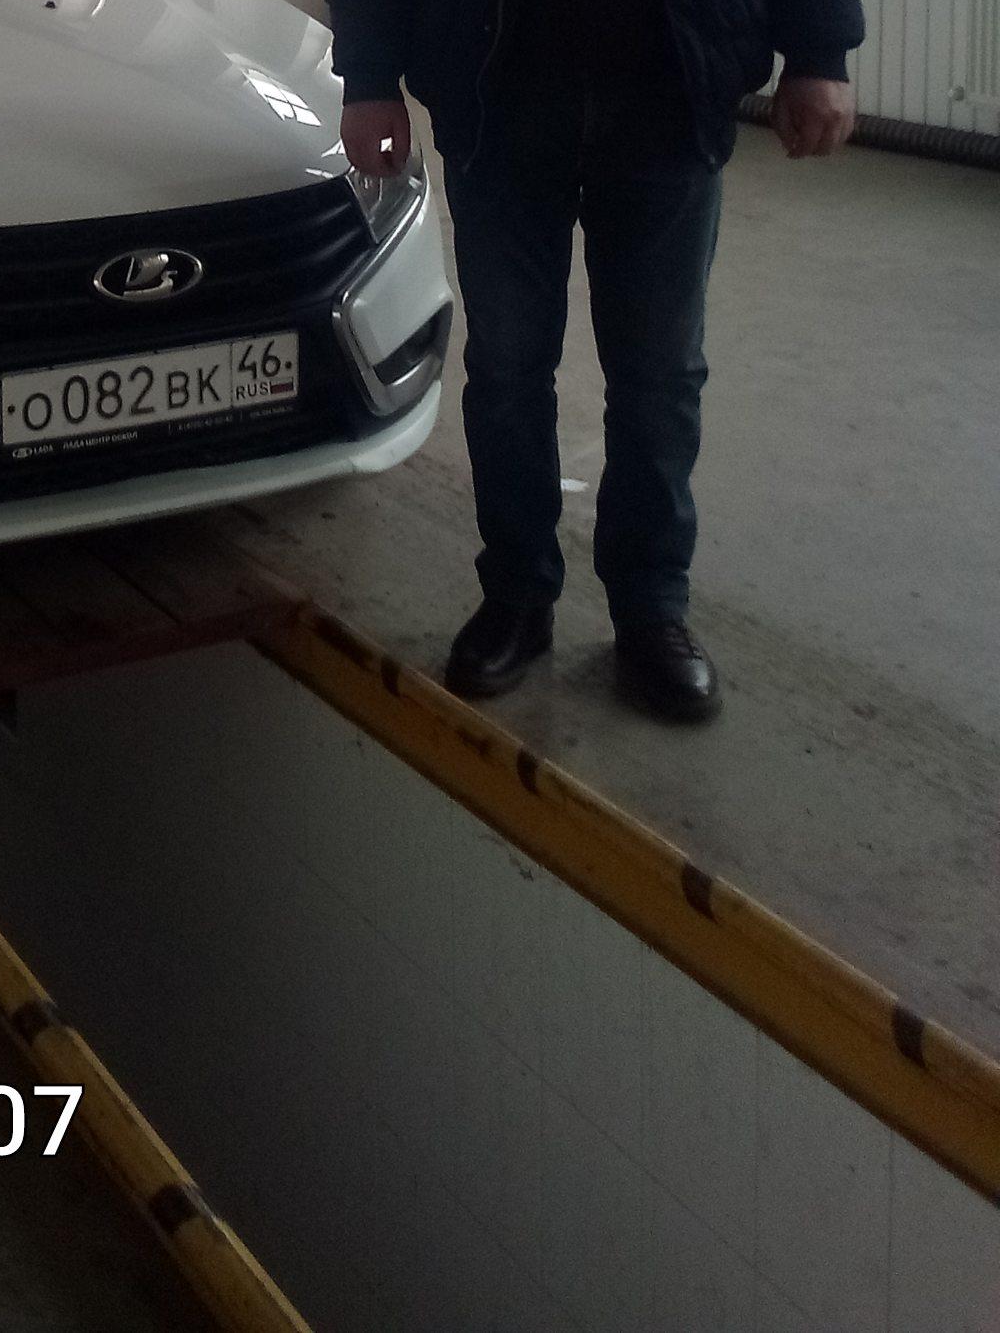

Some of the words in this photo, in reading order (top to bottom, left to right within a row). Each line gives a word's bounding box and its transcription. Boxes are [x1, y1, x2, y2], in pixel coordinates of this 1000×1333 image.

[22, 364, 221, 431] О082ВК
[237, 340, 282, 381] 46
[235, 379, 269, 400] RUS
